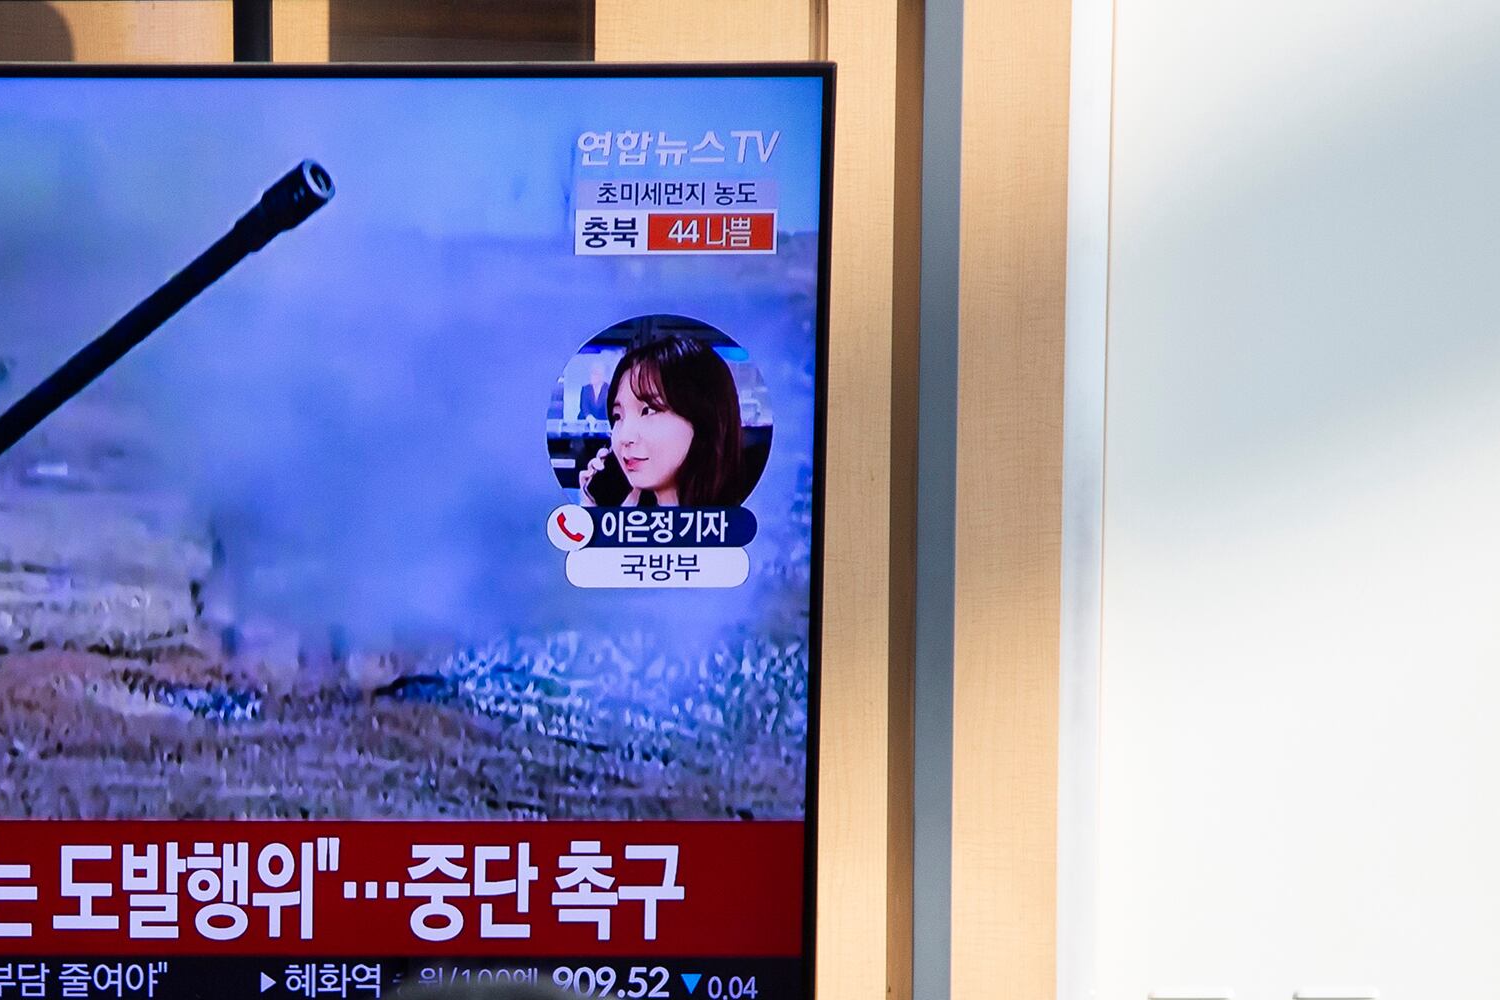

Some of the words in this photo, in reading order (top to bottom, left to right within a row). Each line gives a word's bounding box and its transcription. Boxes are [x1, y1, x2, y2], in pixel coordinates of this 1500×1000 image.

[597, 183, 705, 205] 초미세먼지
[715, 183, 757, 205] 농도
[582, 217, 638, 248] 충북
[669, 220, 699, 243] 44
[706, 216, 752, 247] 나쁨
[602, 511, 674, 543] 이은정
[680, 511, 728, 542] 기자
[621, 554, 700, 581] 국방부
[552, 841, 684, 940] 촉구
[59, 962, 167, 997] 줄여야"
[285, 964, 380, 998] 혜화역
[552, 966, 670, 998] 909.52
[708, 976, 758, 1000] 0.04
